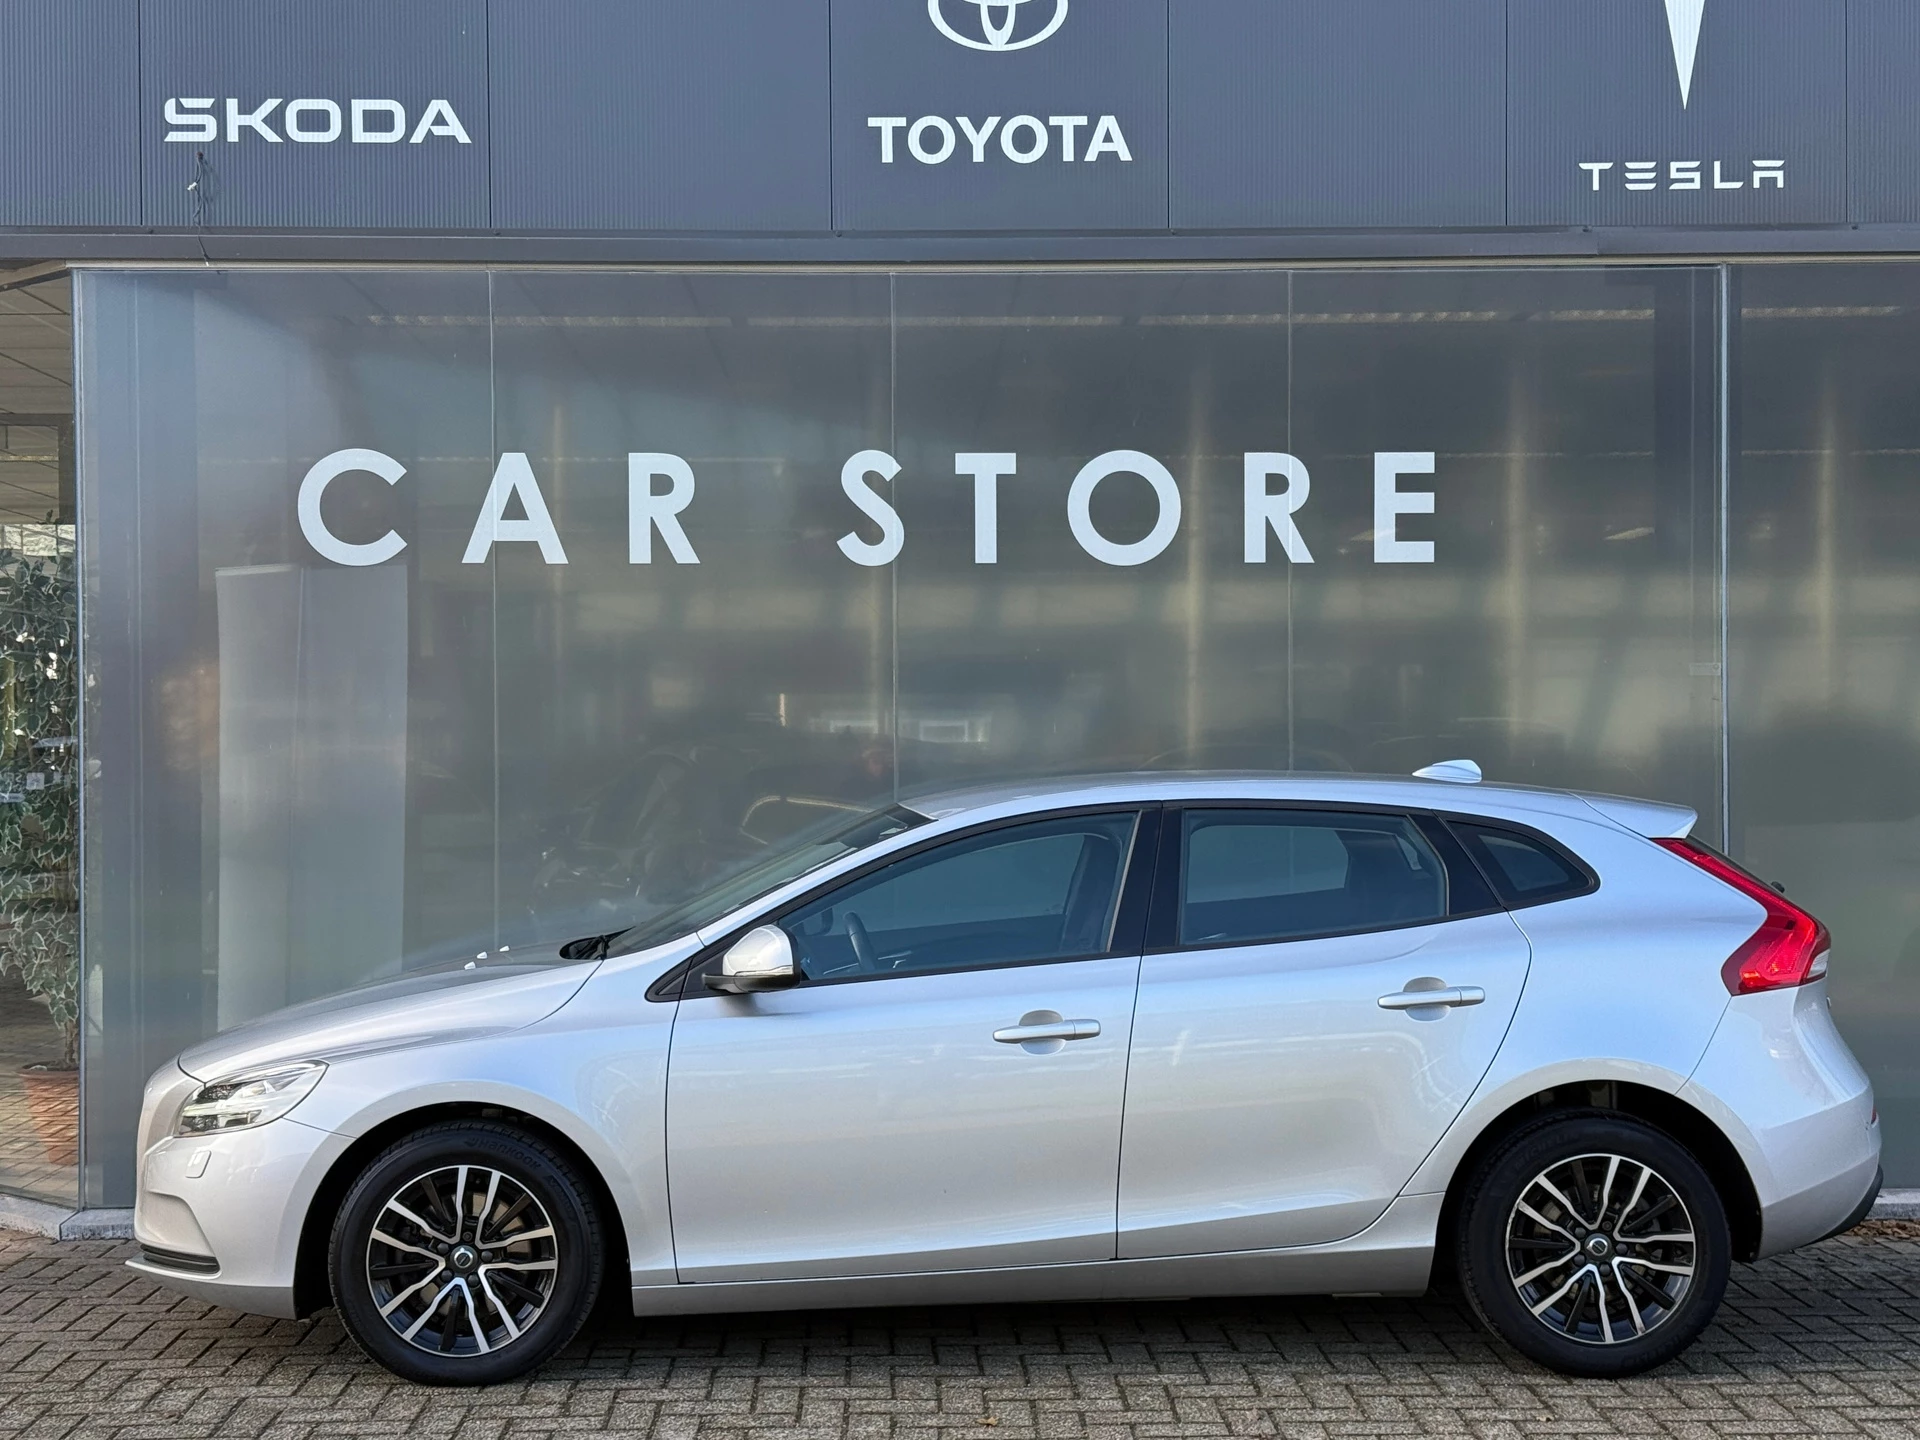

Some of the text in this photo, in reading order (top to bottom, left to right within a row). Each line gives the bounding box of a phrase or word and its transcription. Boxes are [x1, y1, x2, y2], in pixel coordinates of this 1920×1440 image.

[164, 98, 471, 143] SKODA
[868, 115, 1132, 164] TOYOTA
[1579, 160, 1784, 190] TESLA
[298, 449, 1434, 566] CAR STORE
